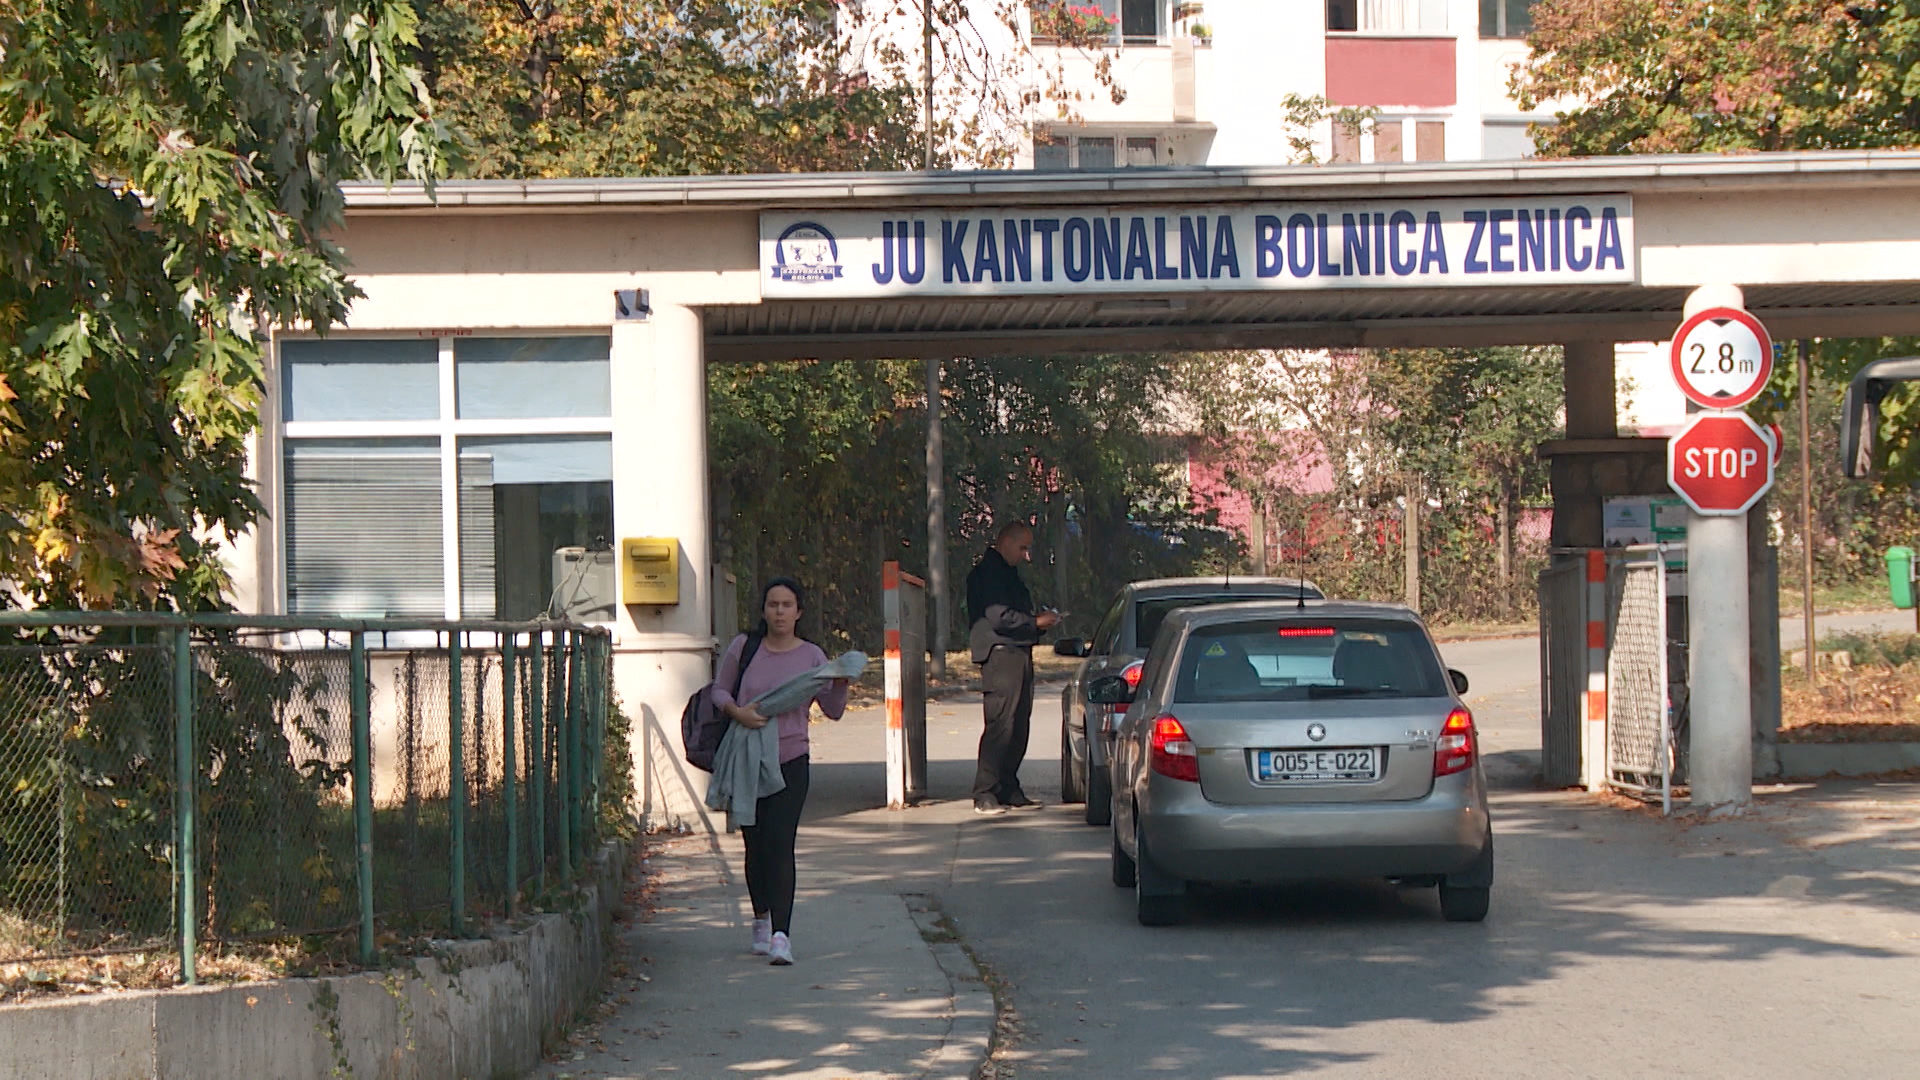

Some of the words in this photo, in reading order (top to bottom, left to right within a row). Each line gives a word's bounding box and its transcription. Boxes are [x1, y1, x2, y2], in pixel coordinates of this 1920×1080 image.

[872, 218, 926, 284] JU
[941, 215, 1240, 283] KANTONALNA
[1255, 209, 1449, 278] BOLNICA
[1463, 205, 1625, 274] ZENICA
[1684, 447, 1758, 478] STOP
